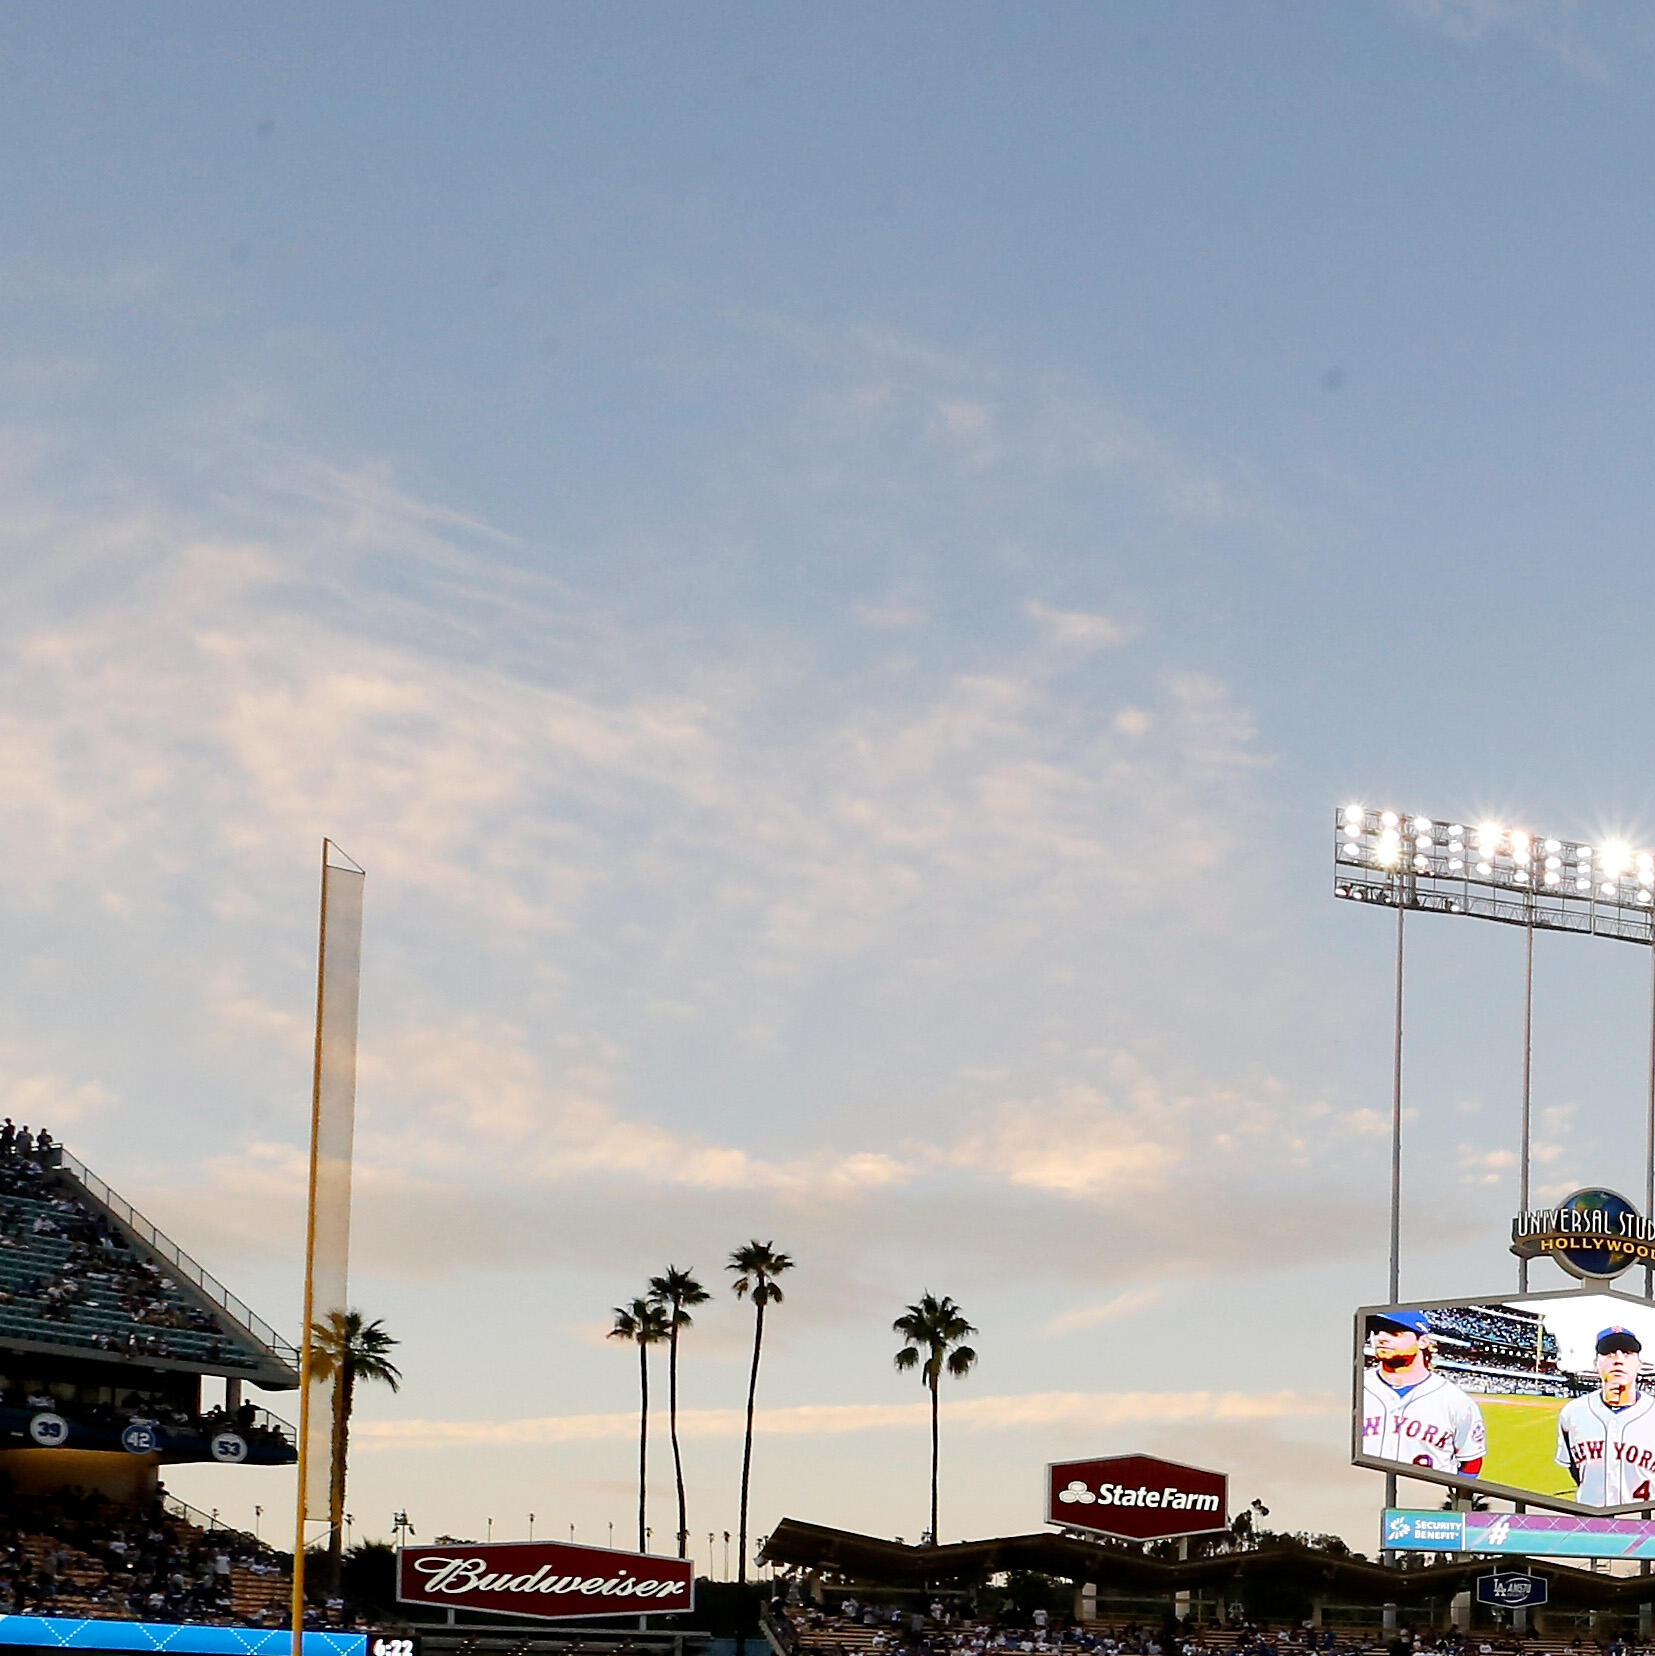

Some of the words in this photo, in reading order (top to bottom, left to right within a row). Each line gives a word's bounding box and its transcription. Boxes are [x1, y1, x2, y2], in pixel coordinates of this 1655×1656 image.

[1518, 1208, 1612, 1238] UNIVERSAL
[37, 1421, 61, 1438] 39
[1391, 1415, 1455, 1450] YORK
[126, 1431, 151, 1448] 42
[218, 1440, 241, 1456] 53
[1632, 1479, 1651, 1501] 4
[1414, 1519, 1462, 1530] SECURITY
[1414, 1530, 1457, 1540] BENEFIT
[413, 1556, 687, 1598] Budweiser
